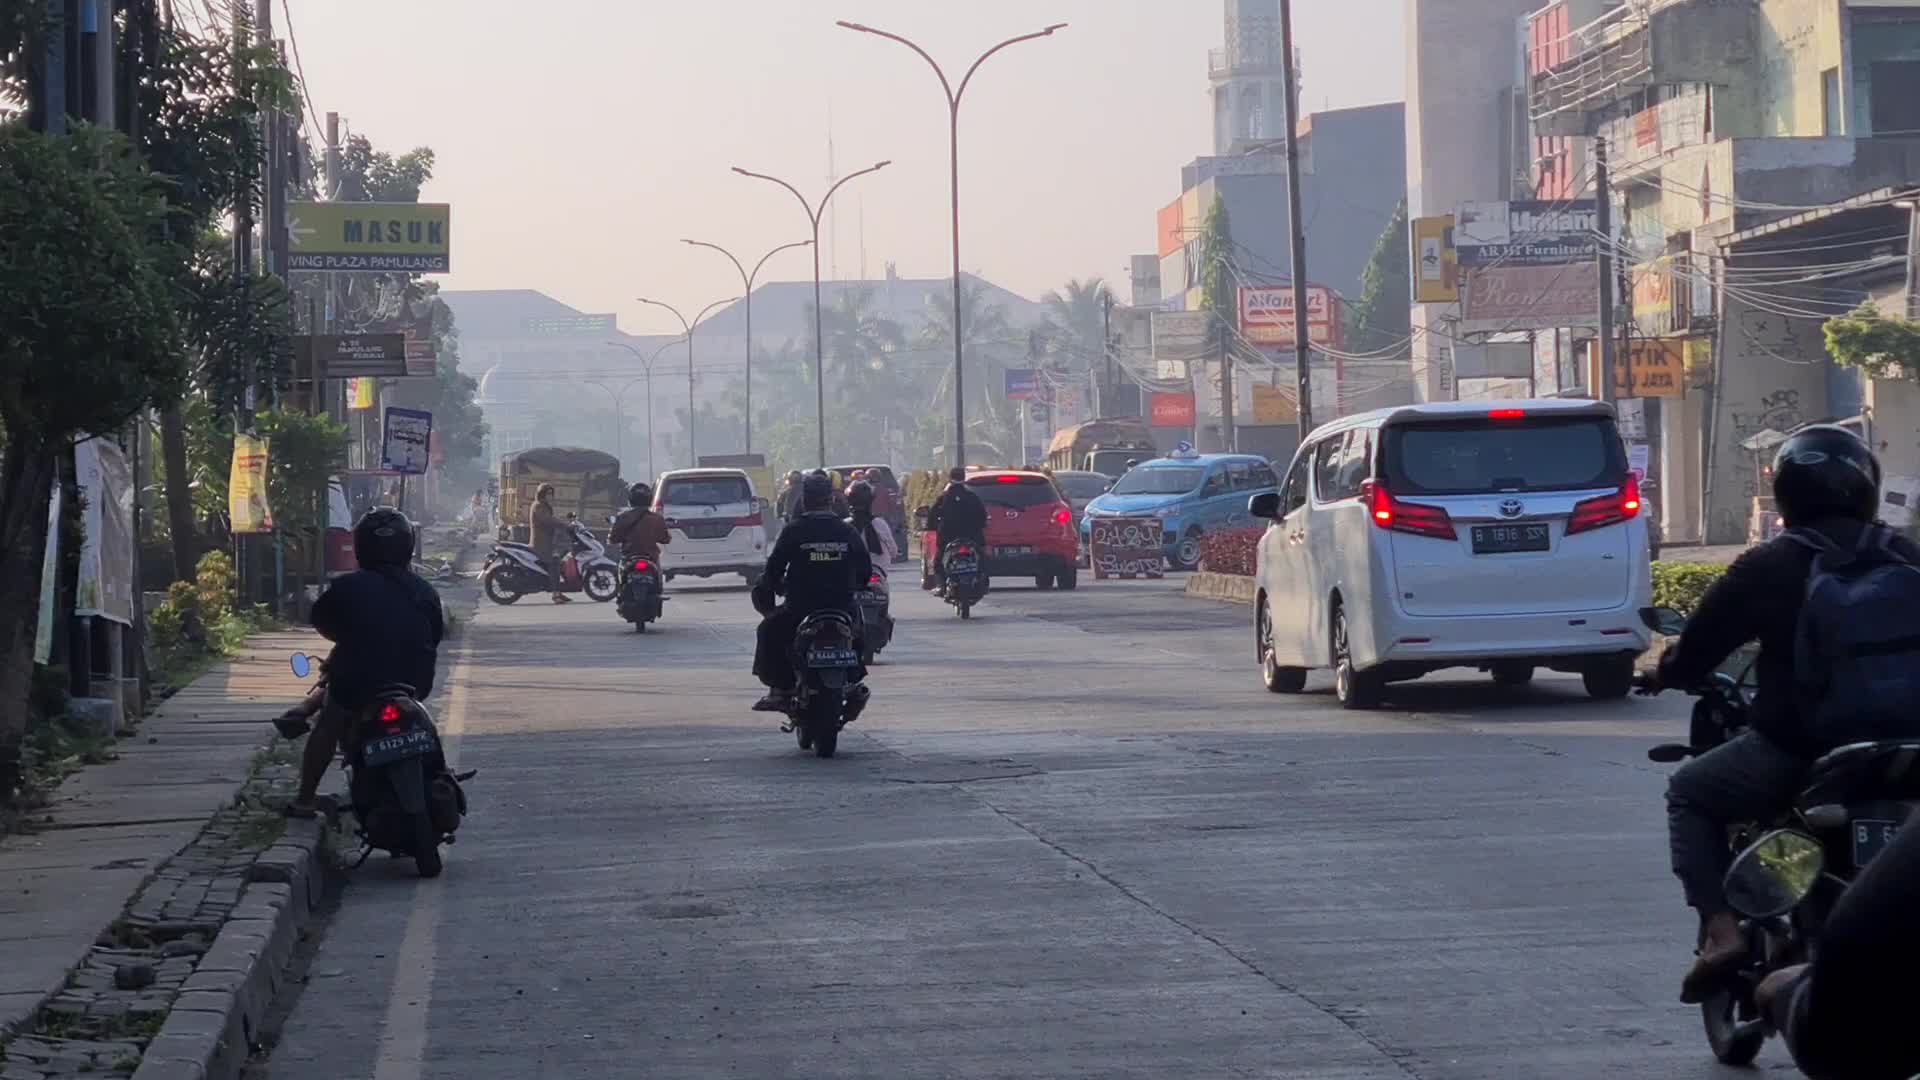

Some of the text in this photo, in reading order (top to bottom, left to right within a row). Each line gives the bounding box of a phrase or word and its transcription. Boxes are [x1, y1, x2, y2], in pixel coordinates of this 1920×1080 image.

[343, 219, 442, 243] MASUK
[288, 255, 443, 269] IVING PLAZA PAMULANG
[1248, 293, 1321, 307] Alfamrt
[1611, 346, 1669, 366] PTIK
[1857, 825, 1868, 843] B
